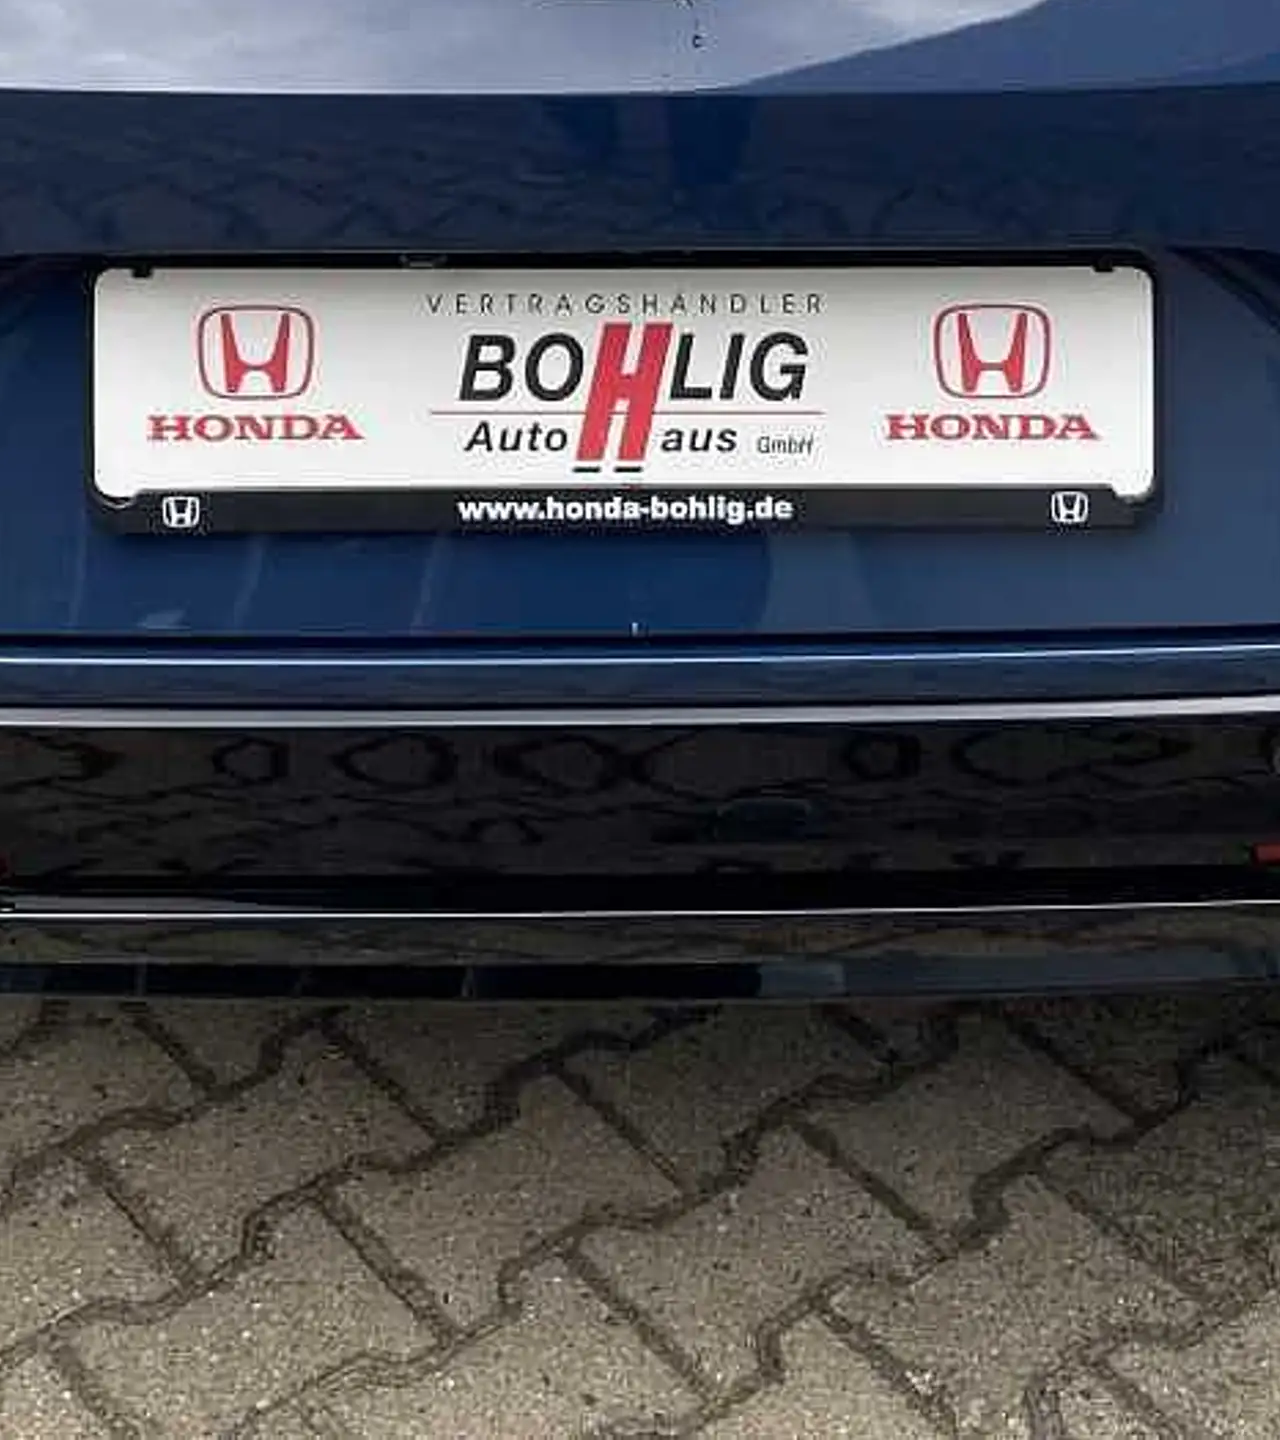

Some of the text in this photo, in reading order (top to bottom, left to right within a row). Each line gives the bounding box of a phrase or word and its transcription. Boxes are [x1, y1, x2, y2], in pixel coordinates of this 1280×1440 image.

[458, 321, 810, 461] BOHLIG
[146, 414, 367, 442] HONDA
[885, 414, 1102, 441] HONDA
[457, 496, 794, 525] www.honda-bohlig.de
